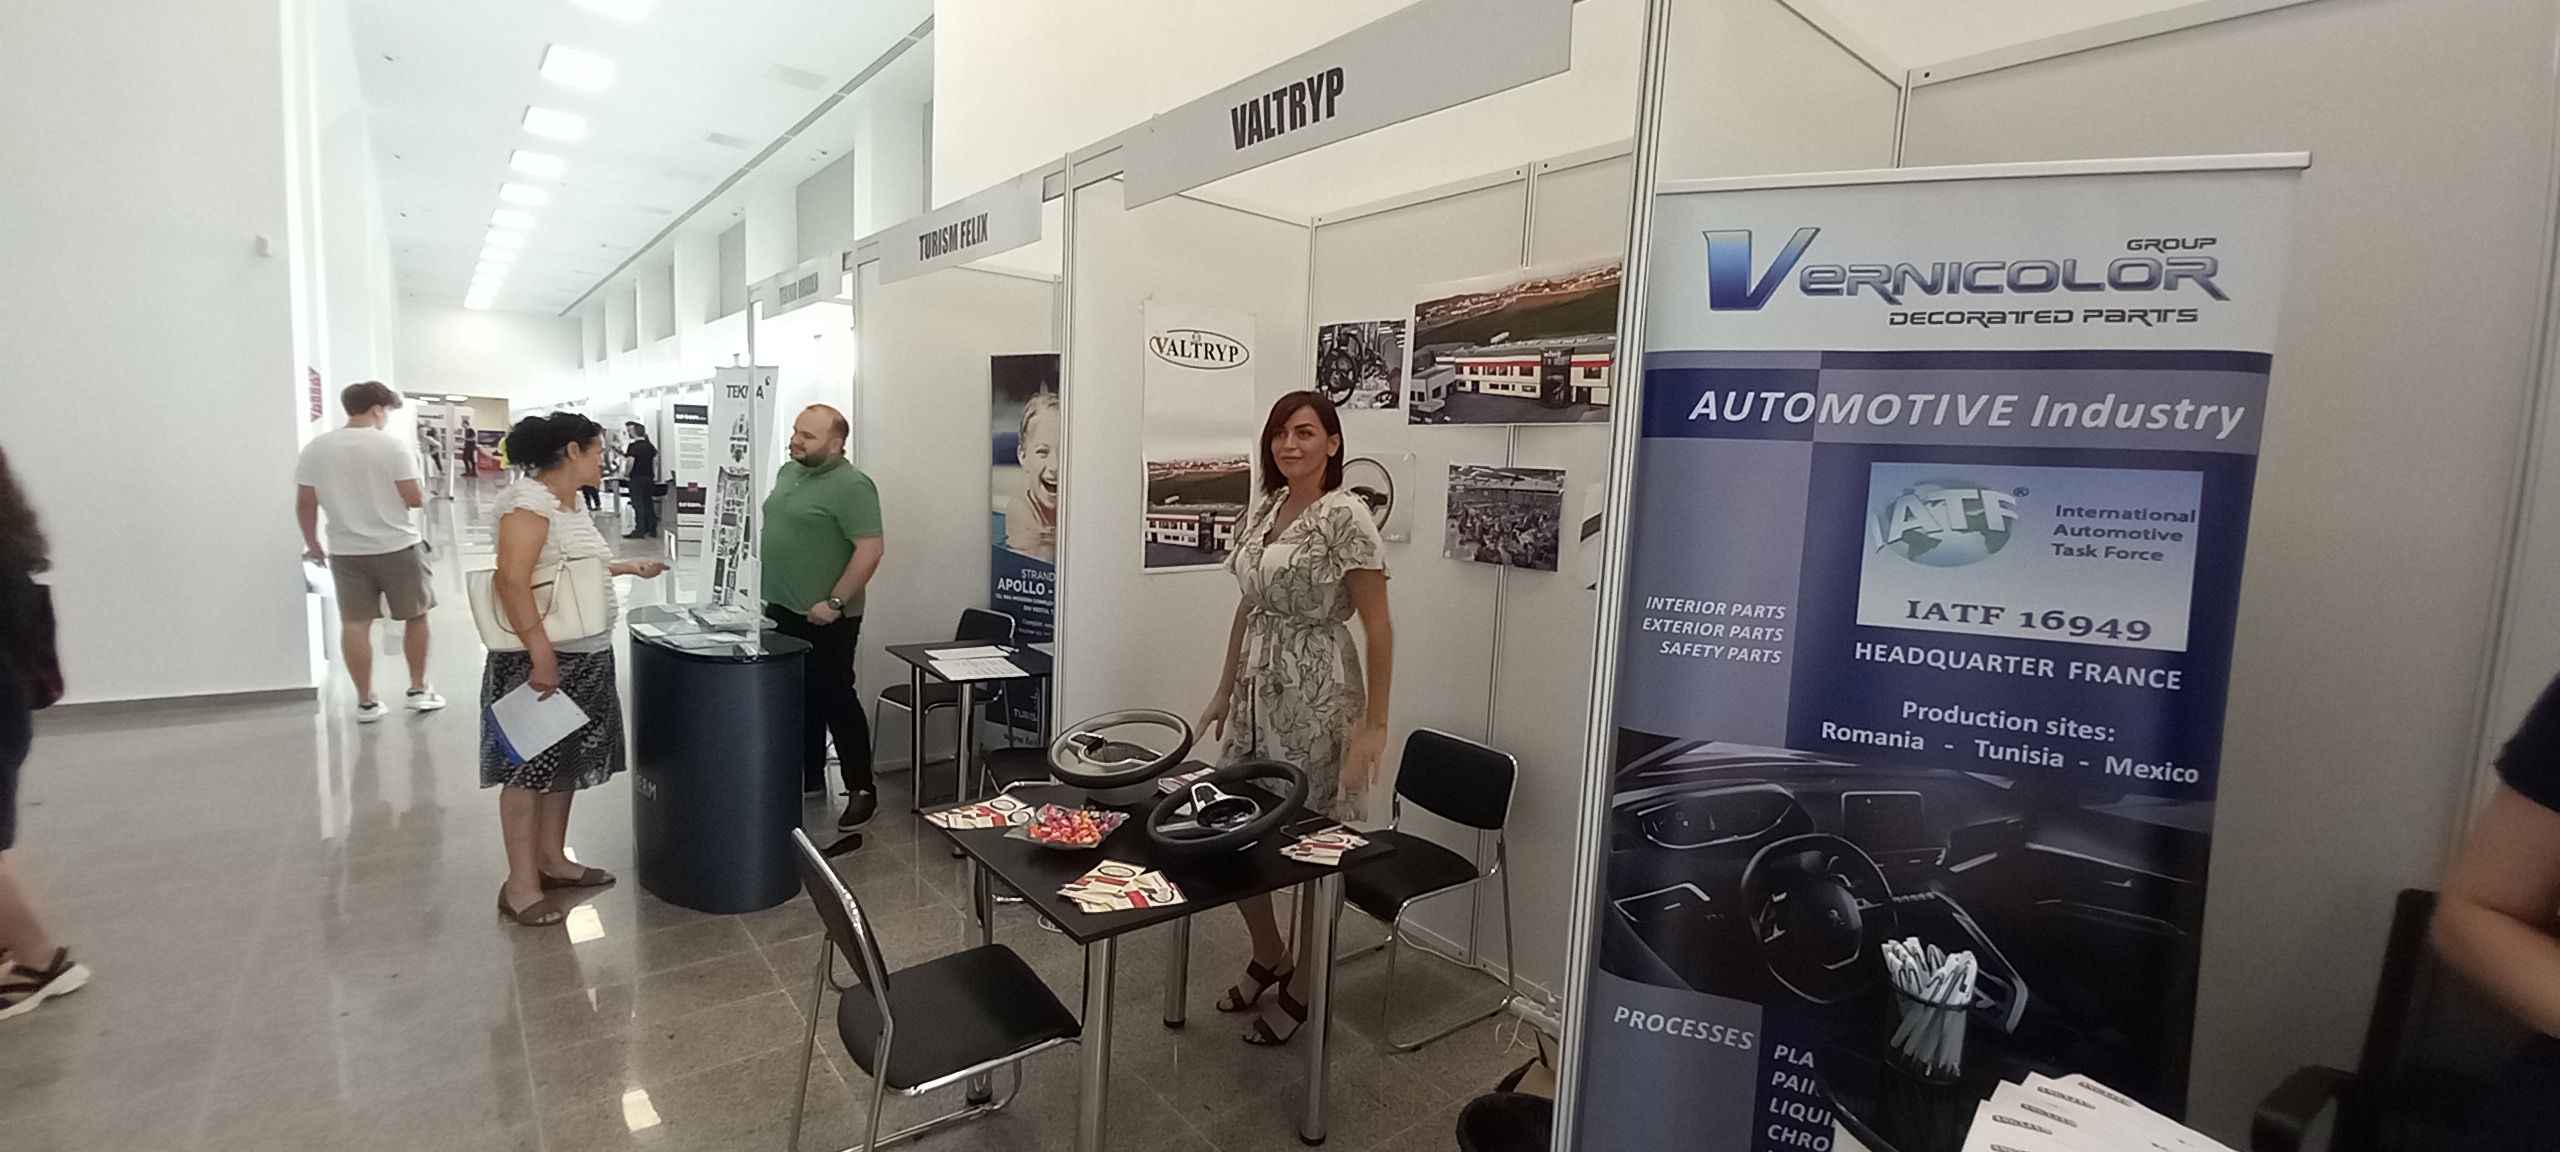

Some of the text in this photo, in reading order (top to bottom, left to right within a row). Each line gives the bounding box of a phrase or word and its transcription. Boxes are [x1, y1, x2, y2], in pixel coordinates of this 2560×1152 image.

[1230, 66, 1344, 150] VALTRYP
[919, 212, 988, 261] TURISM FELIX
[2126, 237, 2217, 253] GROUP
[1155, 336, 1239, 363] VALTRYP
[1688, 390, 2246, 440] AUTOMOTIVE Industry
[2055, 504, 2197, 523] International
[2053, 523, 2184, 543] Automotive
[2051, 542, 2165, 562] Task Force
[997, 577, 1046, 596] APOLLO
[1645, 595, 1787, 619] INTERIOR PARTS
[1905, 600, 2152, 642] IATF 16949
[1642, 617, 1785, 642] EXTERIOR PARTS
[1659, 640, 1783, 664] SAFETY PARTS
[1854, 641, 2182, 690] HEADQUARTER FRANCE
[1902, 700, 2116, 743] Production sites:
[1821, 721, 1925, 751] Romania
[1974, 738, 2065, 768] Tunisia
[2105, 755, 2200, 784] Mexico
[1613, 1005, 1755, 1050] PROCESSES
[1773, 1043, 1815, 1069] PLA
[1768, 1096, 1835, 1128] LIQUI
[1767, 1123, 1830, 1152] CHRO
